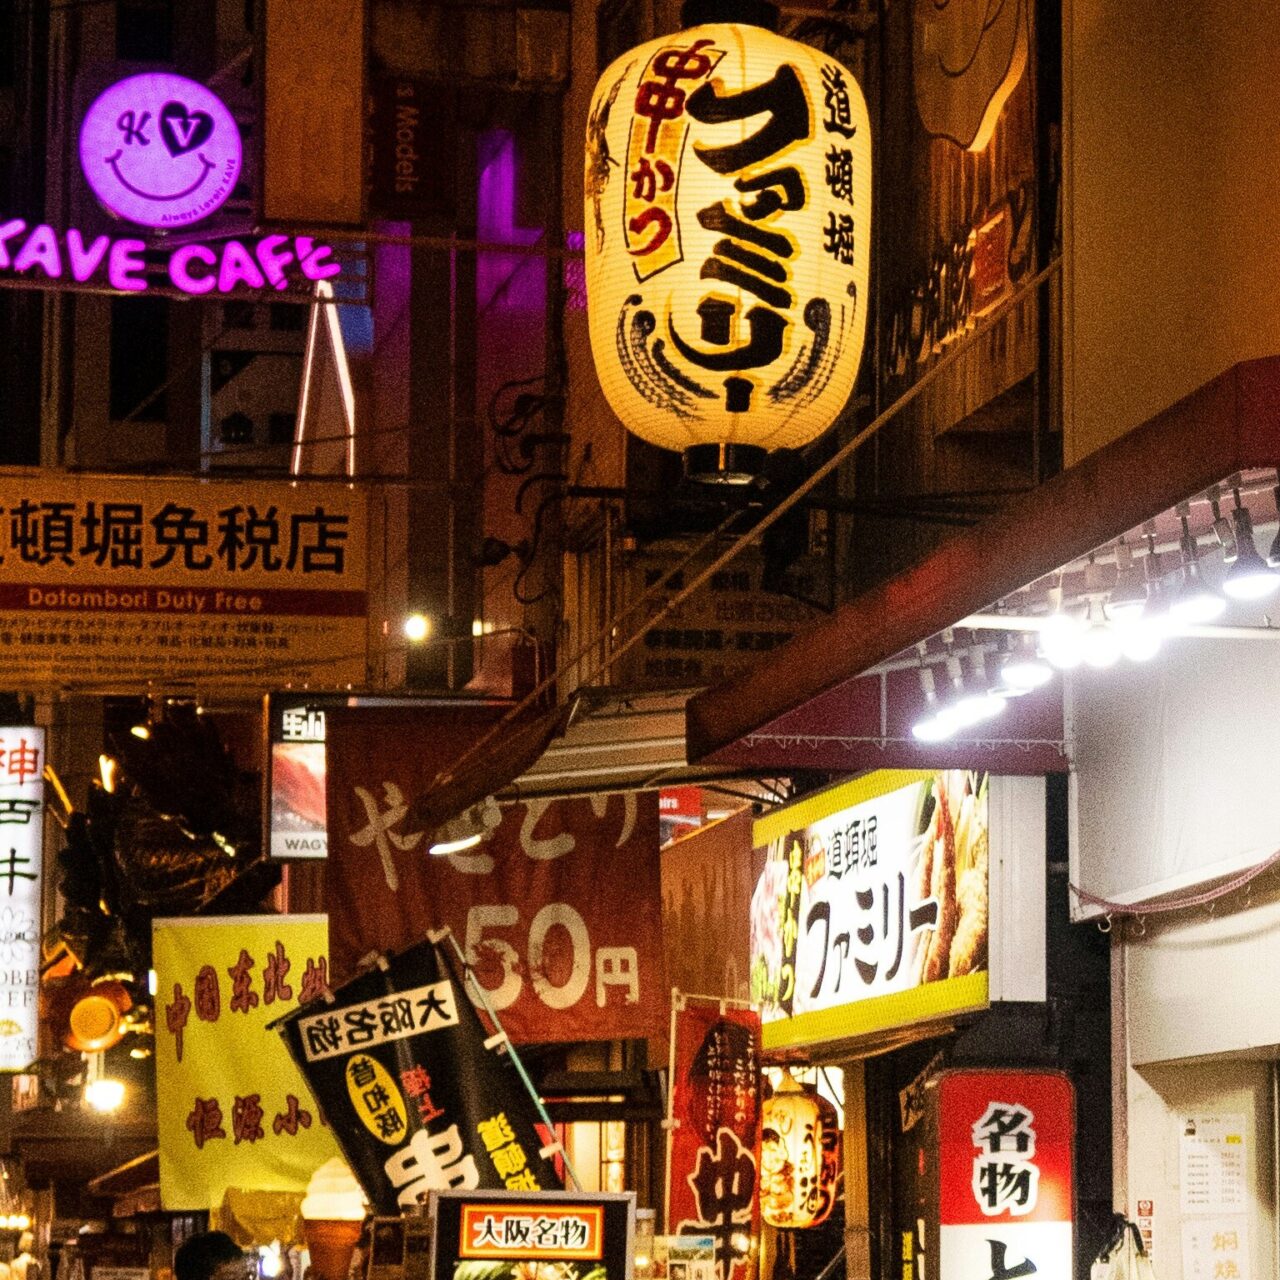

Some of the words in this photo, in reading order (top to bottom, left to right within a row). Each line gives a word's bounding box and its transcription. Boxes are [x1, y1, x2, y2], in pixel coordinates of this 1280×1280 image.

[165, 116, 201, 148] V
[821, 63, 857, 266] 道頓堀
[168, 233, 342, 295] CAFE
[0, 498, 350, 576] 頓堀免税店
[156, 590, 208, 613] Duty
[215, 591, 264, 611] Free
[826, 814, 879, 881] 道頓堀
[805, 870, 939, 1000] ファミリー
[975, 1104, 1037, 1213] 名物
[473, 1217, 590, 1249] 大阪名物
